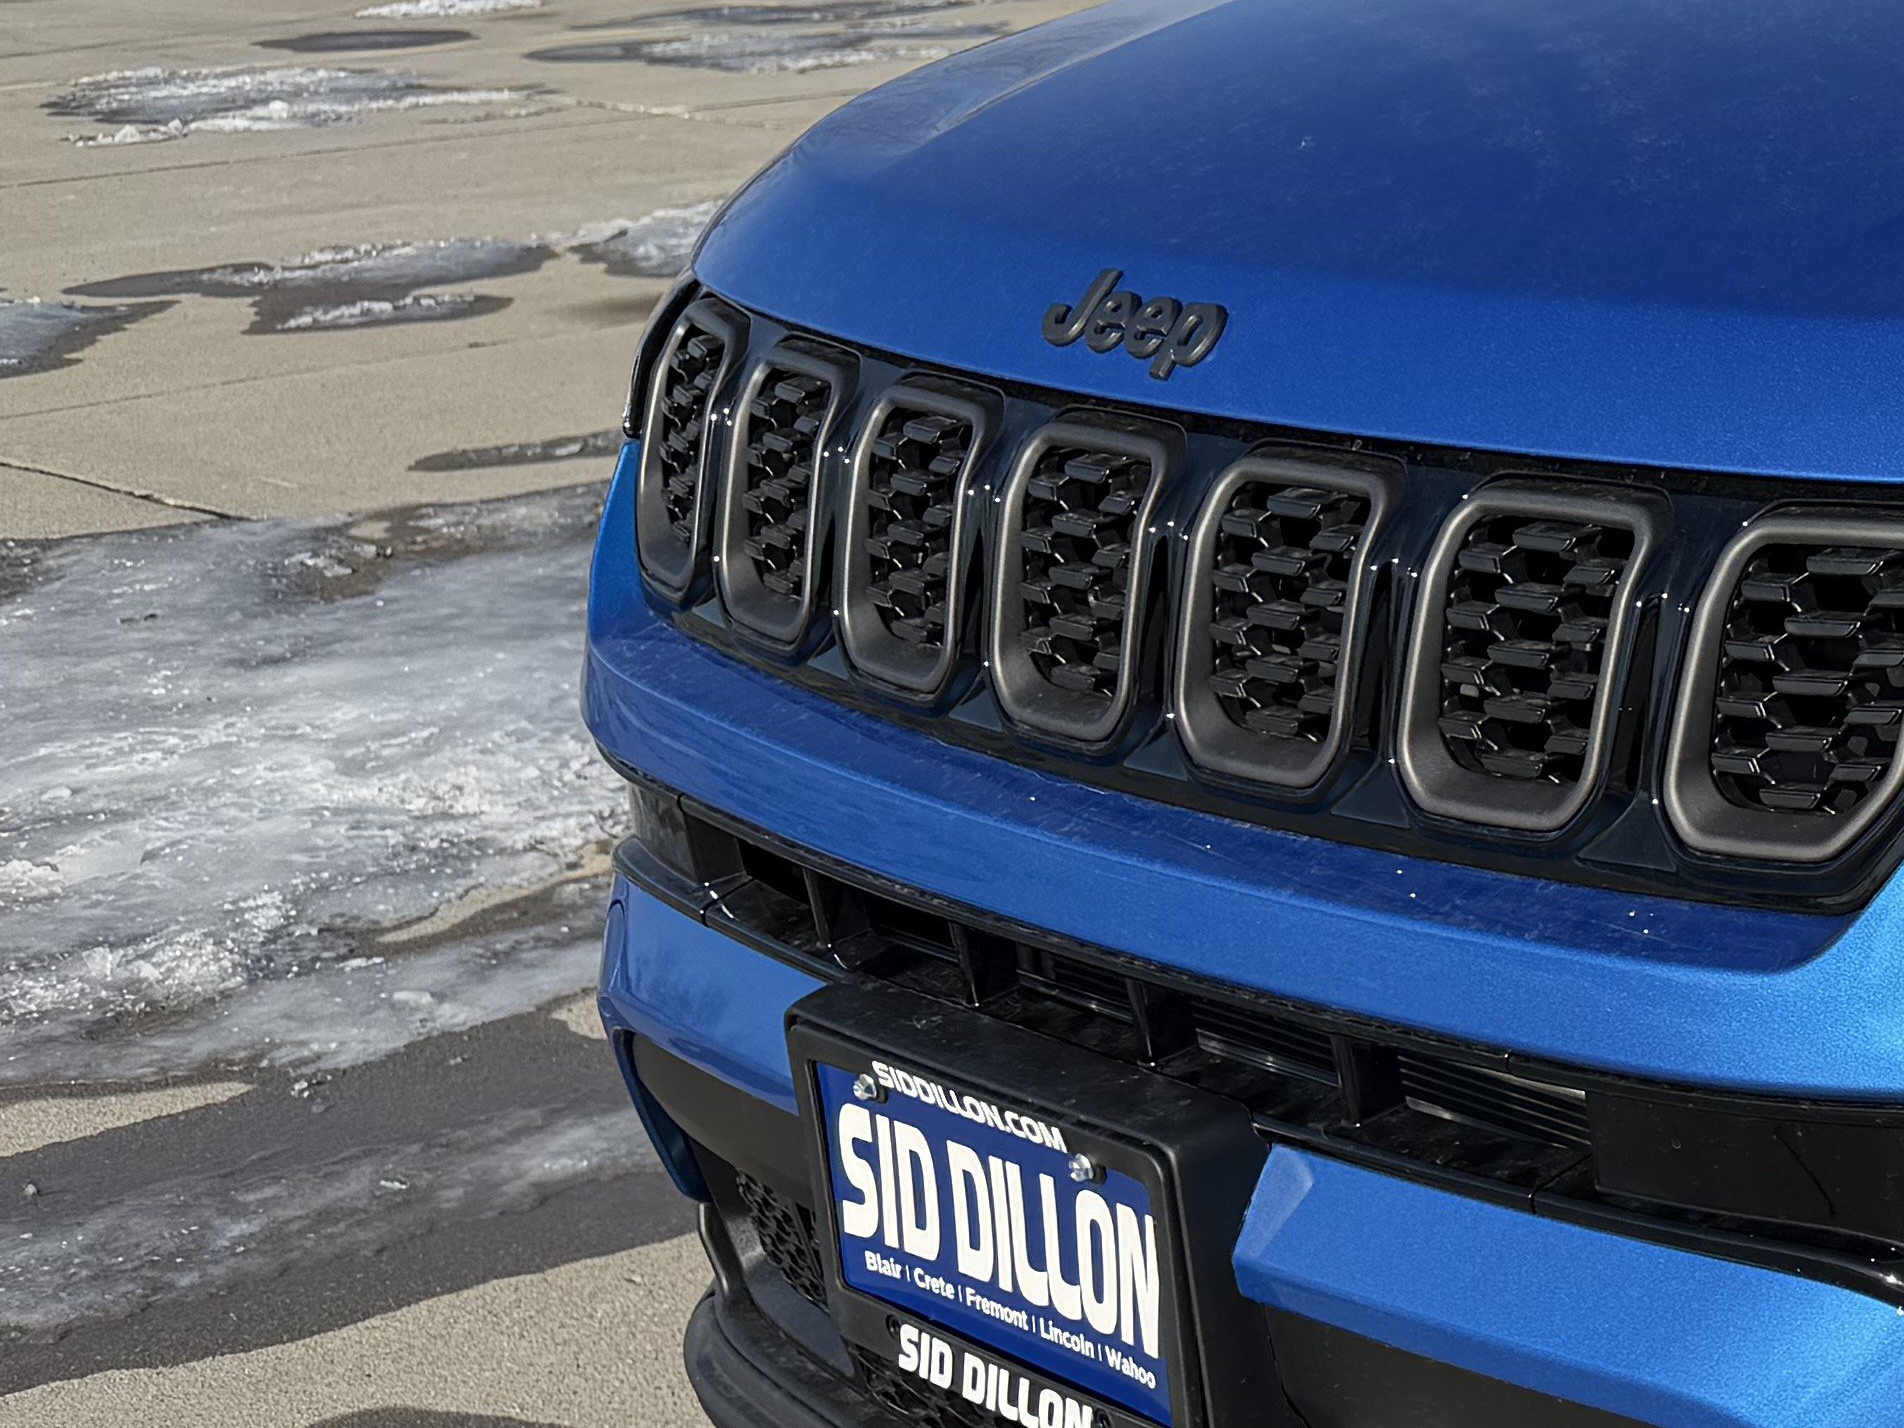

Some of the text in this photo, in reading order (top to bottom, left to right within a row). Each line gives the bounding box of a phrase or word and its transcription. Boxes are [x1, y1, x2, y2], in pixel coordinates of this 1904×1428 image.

[1041, 268, 1229, 381] Jeep
[872, 1060, 1068, 1154] SIDDILLON.COM
[838, 1102, 1160, 1360] SID DILLON
[864, 1250, 1157, 1390] Blair Crete Fremont Lincoln Wahoo
[898, 1323, 953, 1390] SID
